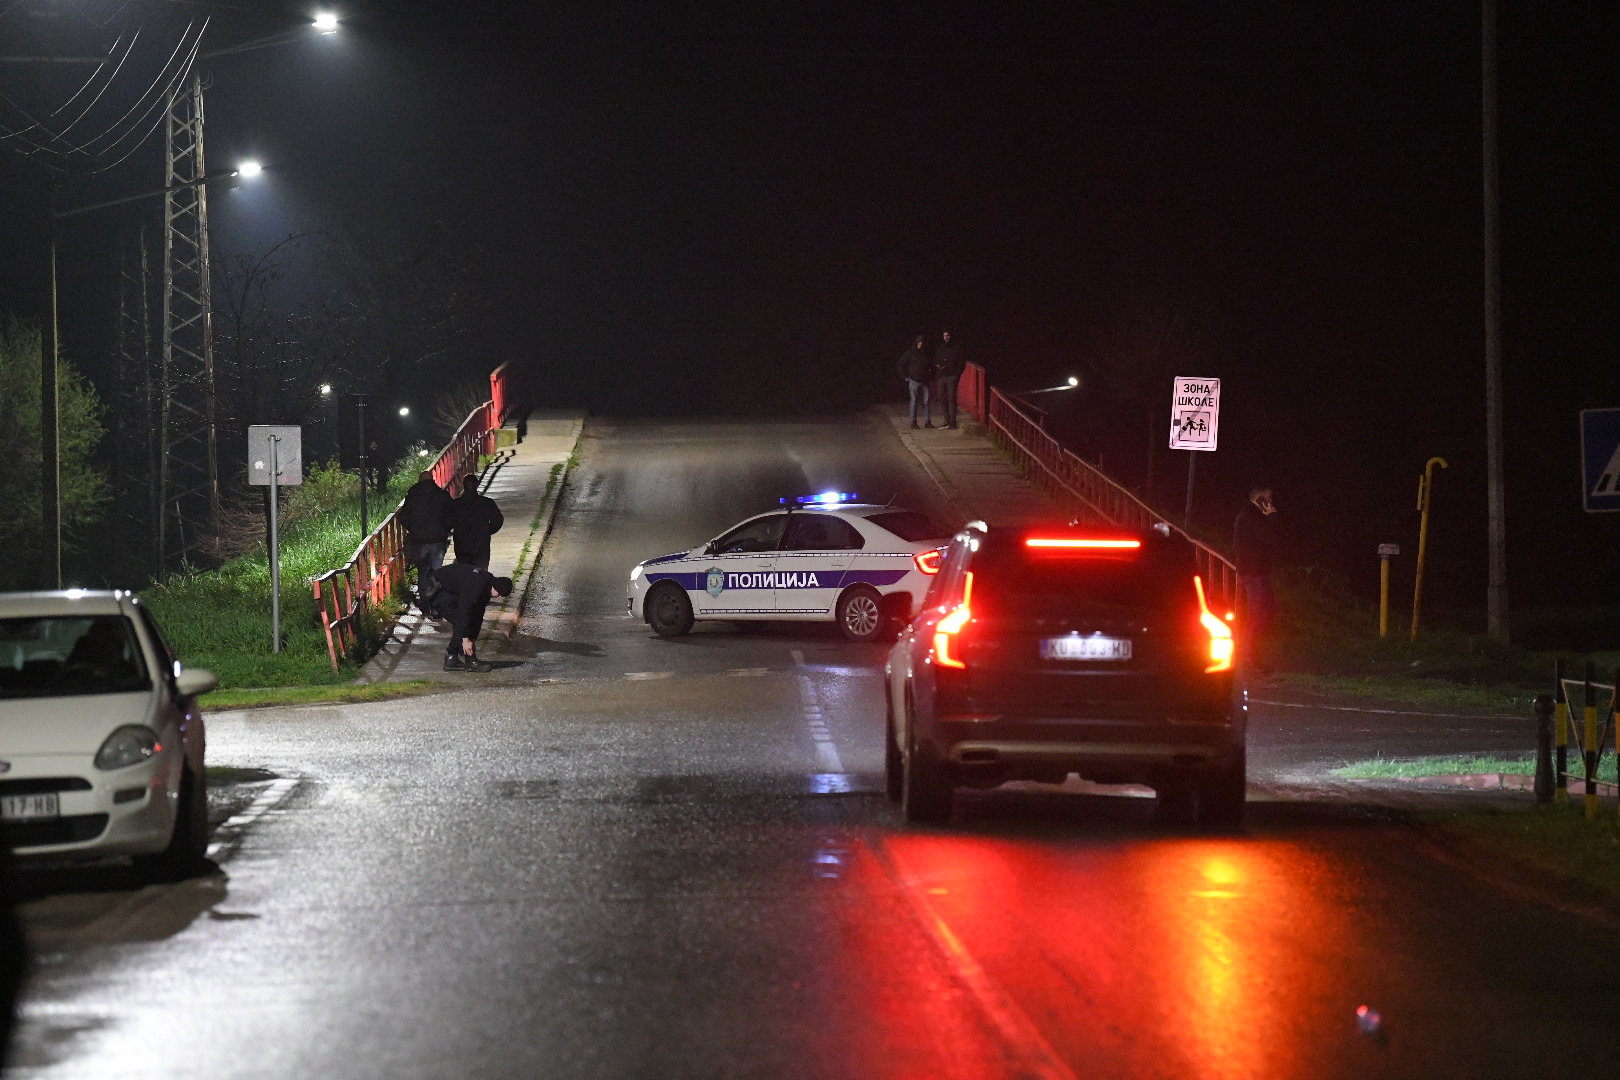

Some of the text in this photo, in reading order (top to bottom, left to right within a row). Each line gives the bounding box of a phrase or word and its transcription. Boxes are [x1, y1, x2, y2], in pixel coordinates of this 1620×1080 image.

[1183, 383, 1211, 394] ЗОНА
[1178, 396, 1215, 407] ШКОЛЕ
[728, 572, 820, 589] ПОЛИЦИЈА
